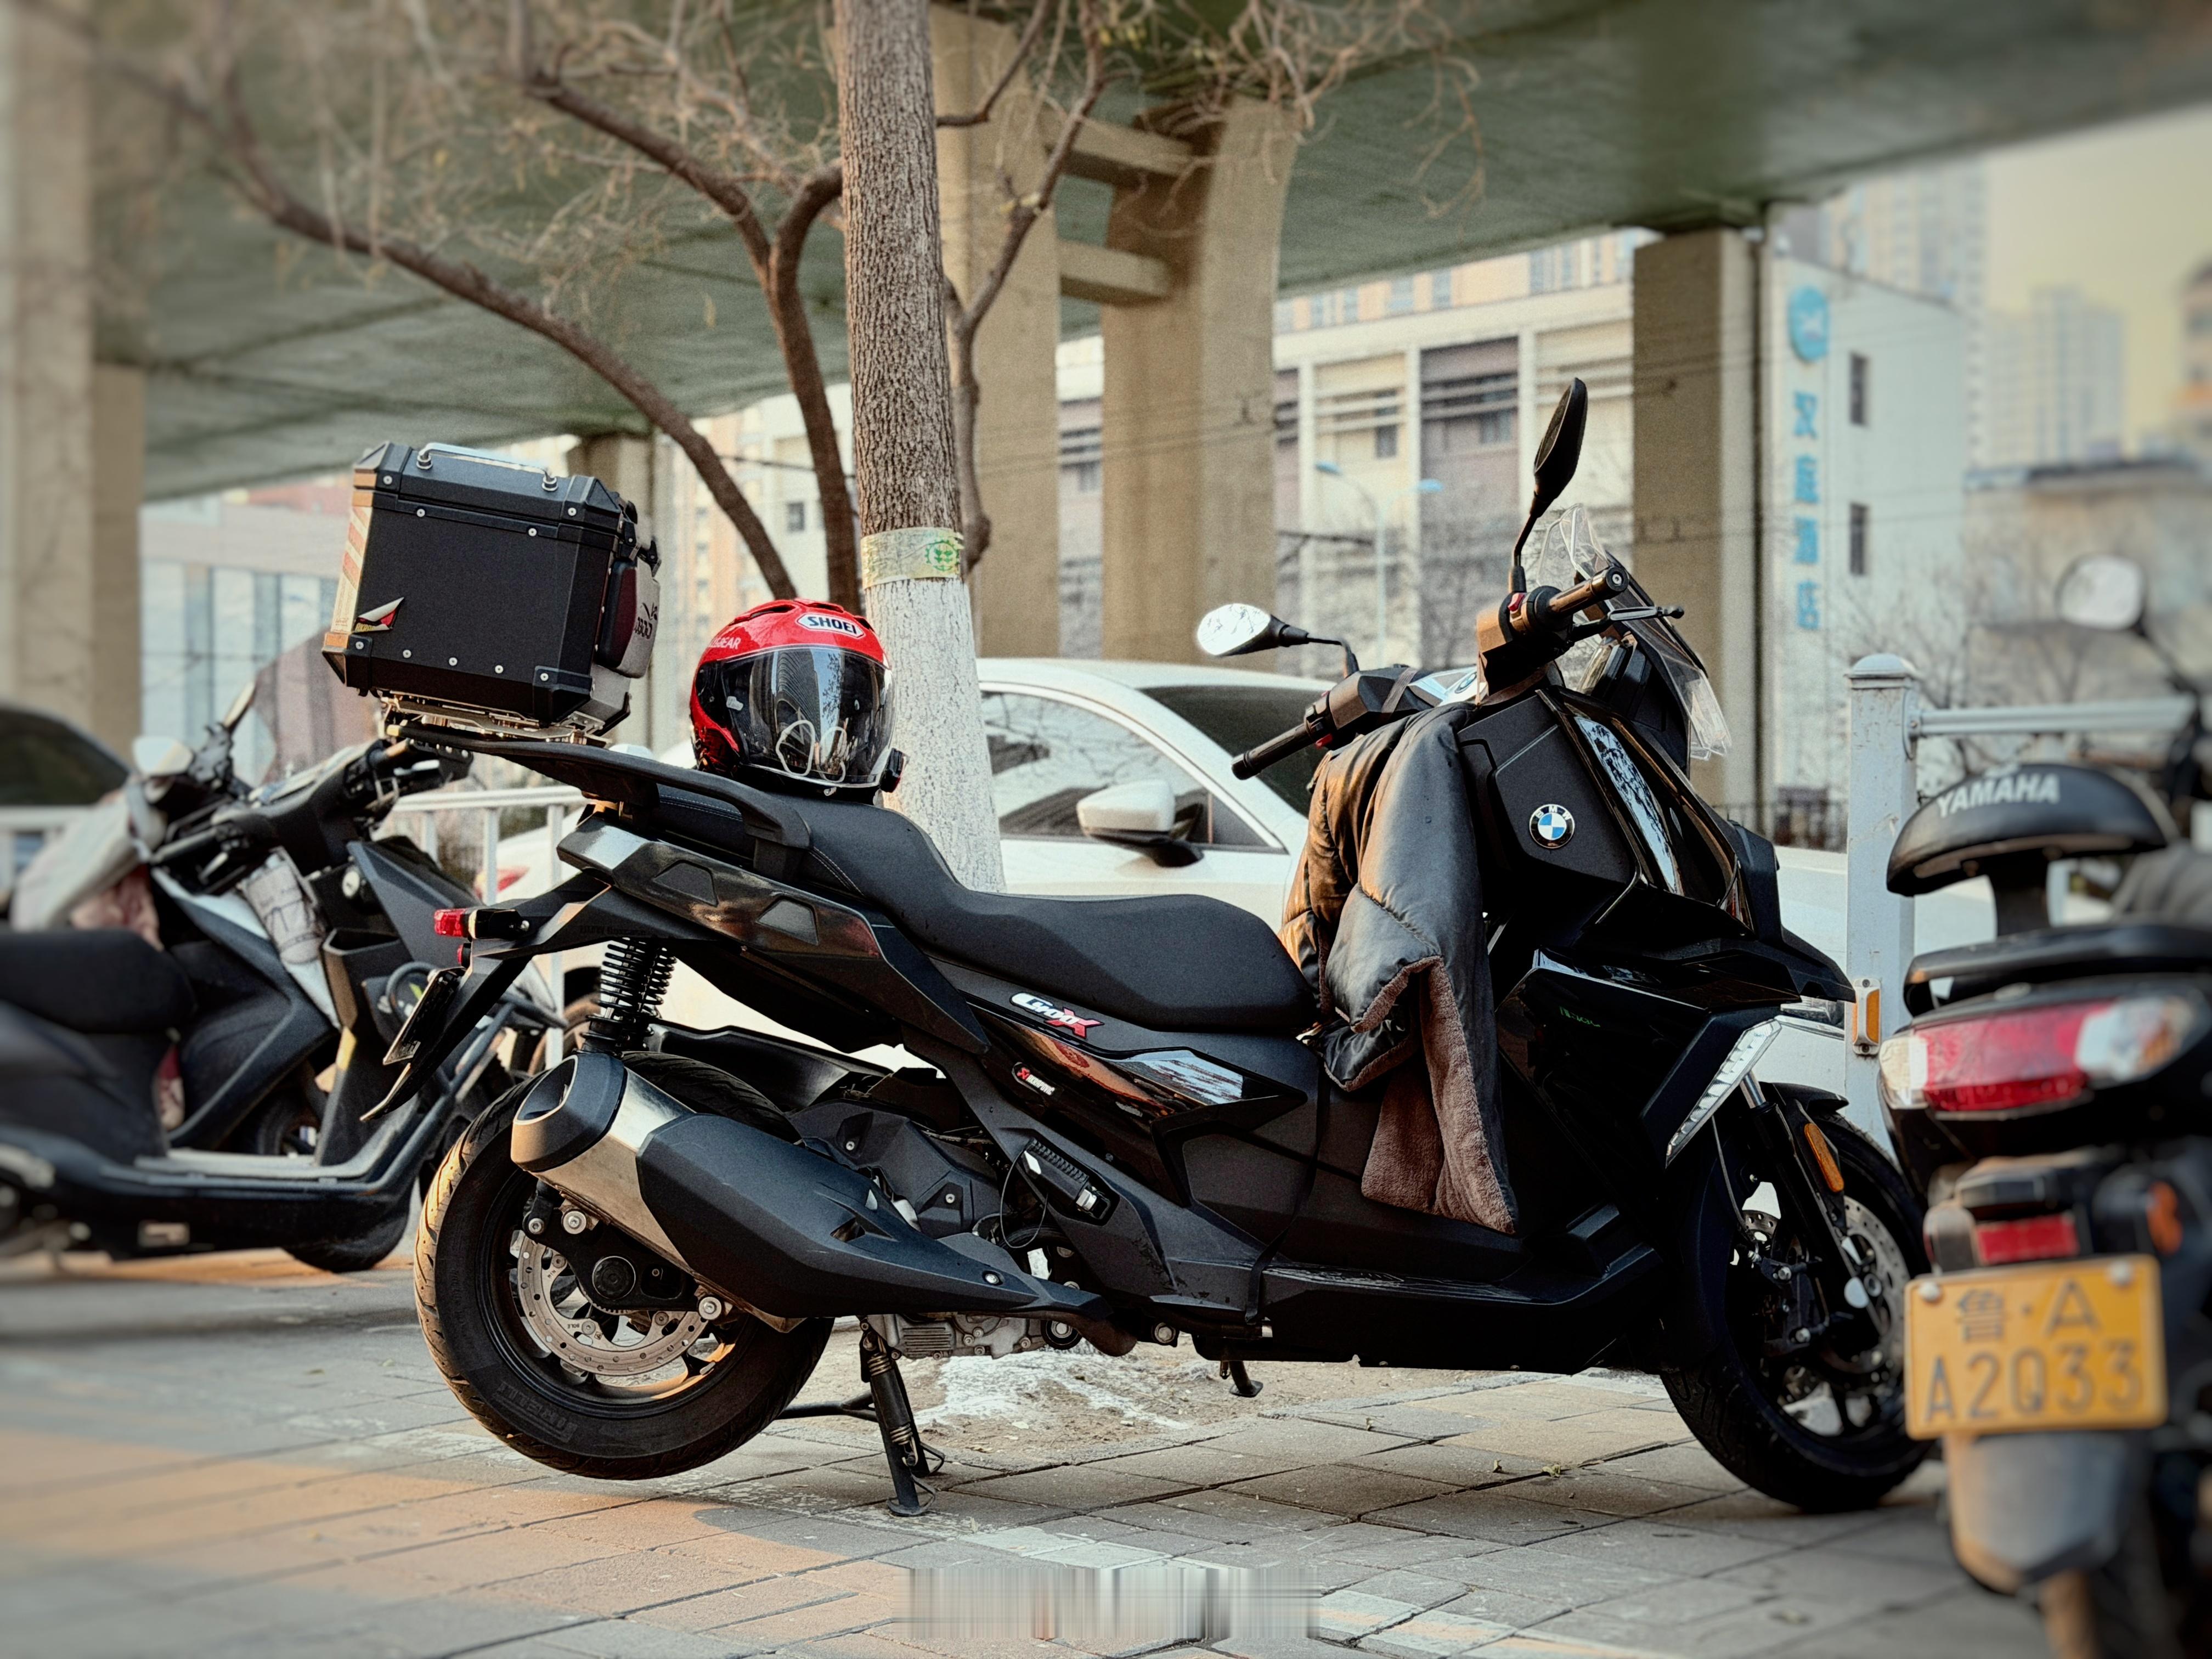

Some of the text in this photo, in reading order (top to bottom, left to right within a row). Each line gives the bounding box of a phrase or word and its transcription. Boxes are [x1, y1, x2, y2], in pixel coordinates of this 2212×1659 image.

[807, 616, 857, 635] SHOEI
[1936, 772, 2061, 818] YAMAHA
[1535, 805, 1572, 820] BMW
